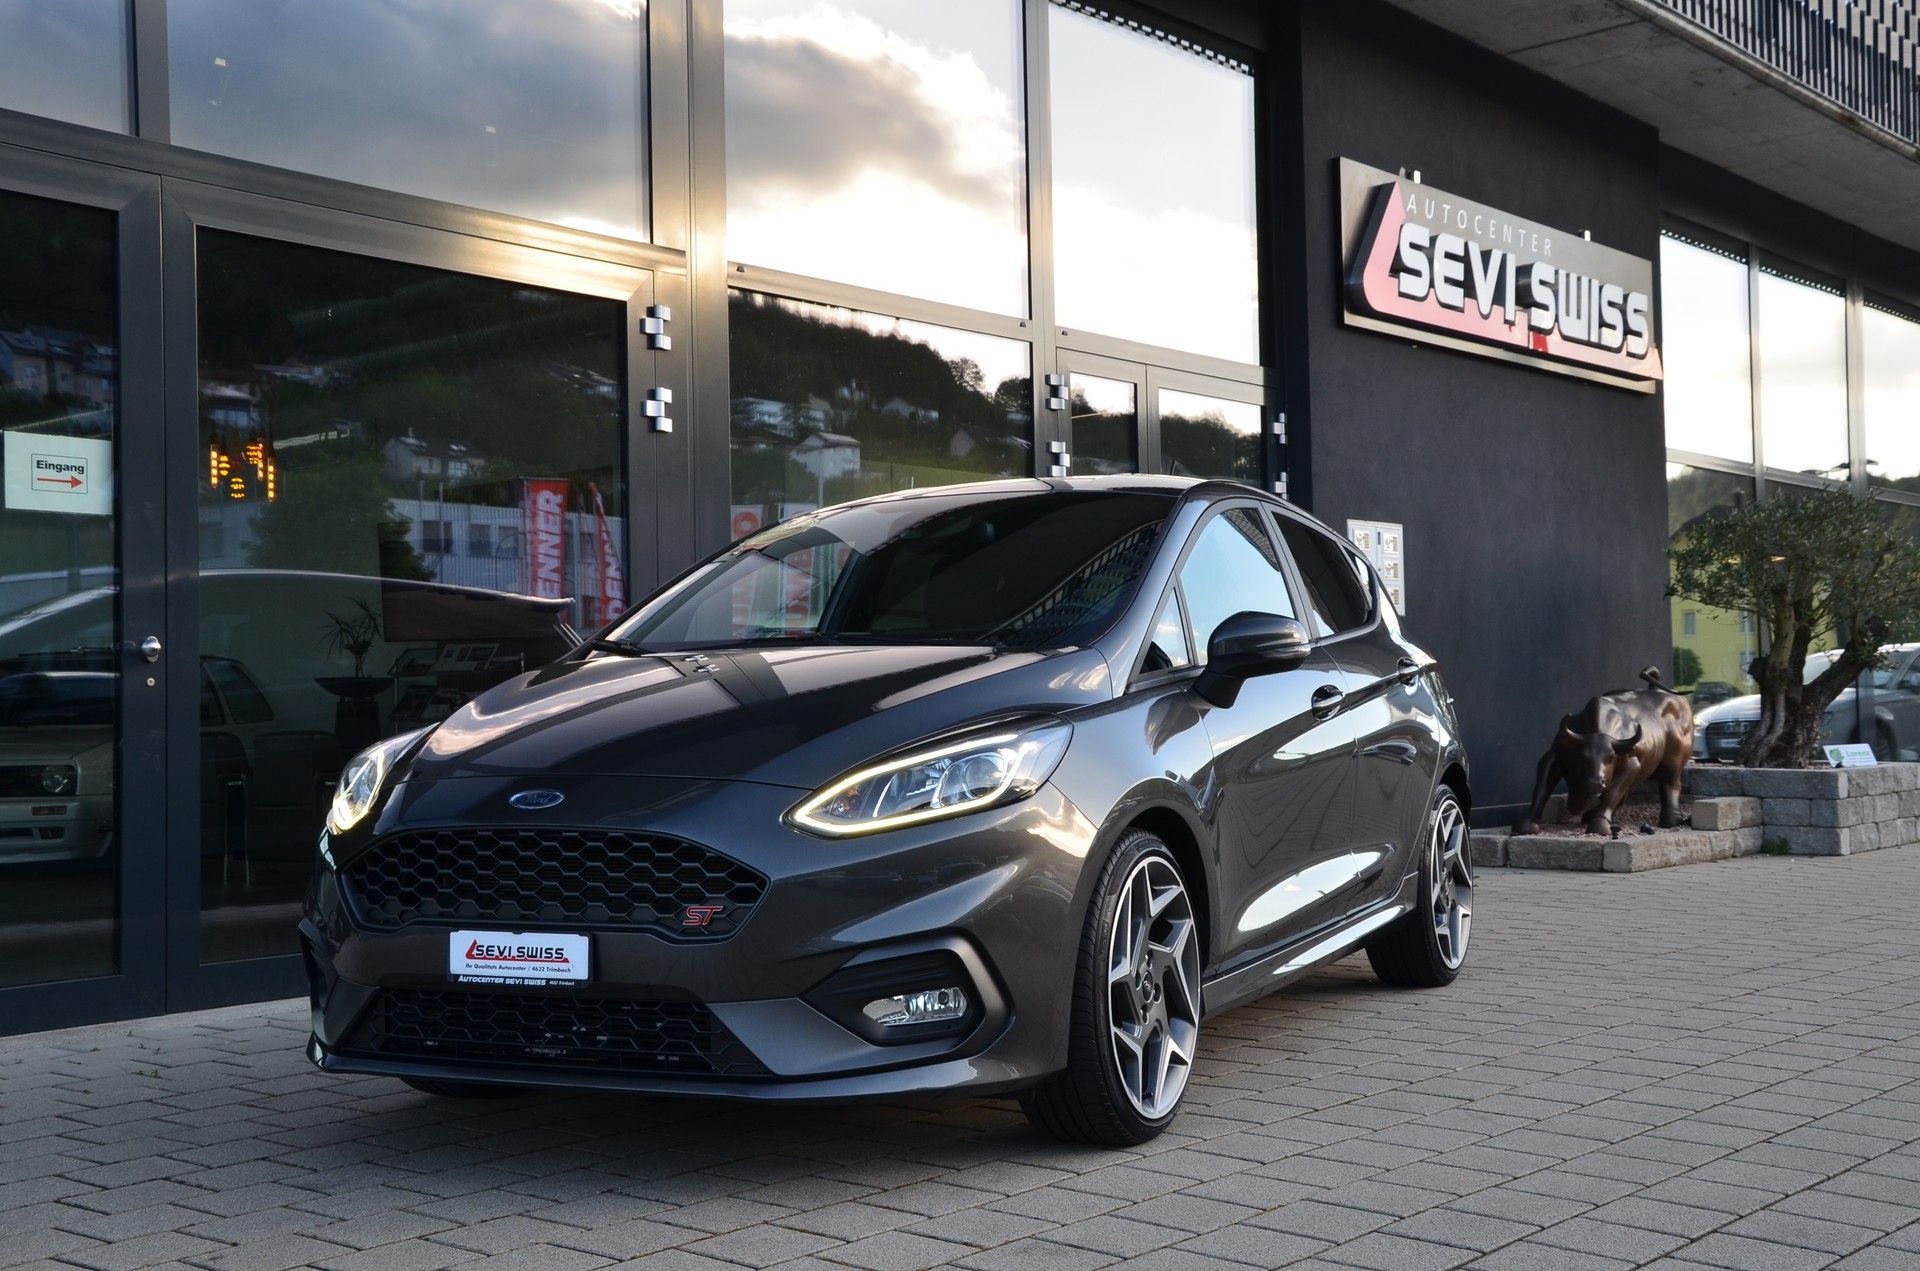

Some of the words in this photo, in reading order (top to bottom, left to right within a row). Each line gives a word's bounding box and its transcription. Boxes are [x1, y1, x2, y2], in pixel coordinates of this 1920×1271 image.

[1406, 193, 1551, 257] AUTOCENTER
[1398, 222, 1516, 324] SEVI
[1529, 261, 1649, 358] SWISS
[36, 459, 85, 475] Eingang
[537, 489, 564, 599] ENNER
[682, 905, 724, 926] ST
[475, 944, 512, 958] SEVI
[516, 946, 564, 960] SWISS
[505, 977, 523, 985] SEVI
[523, 978, 546, 986] SWISS
